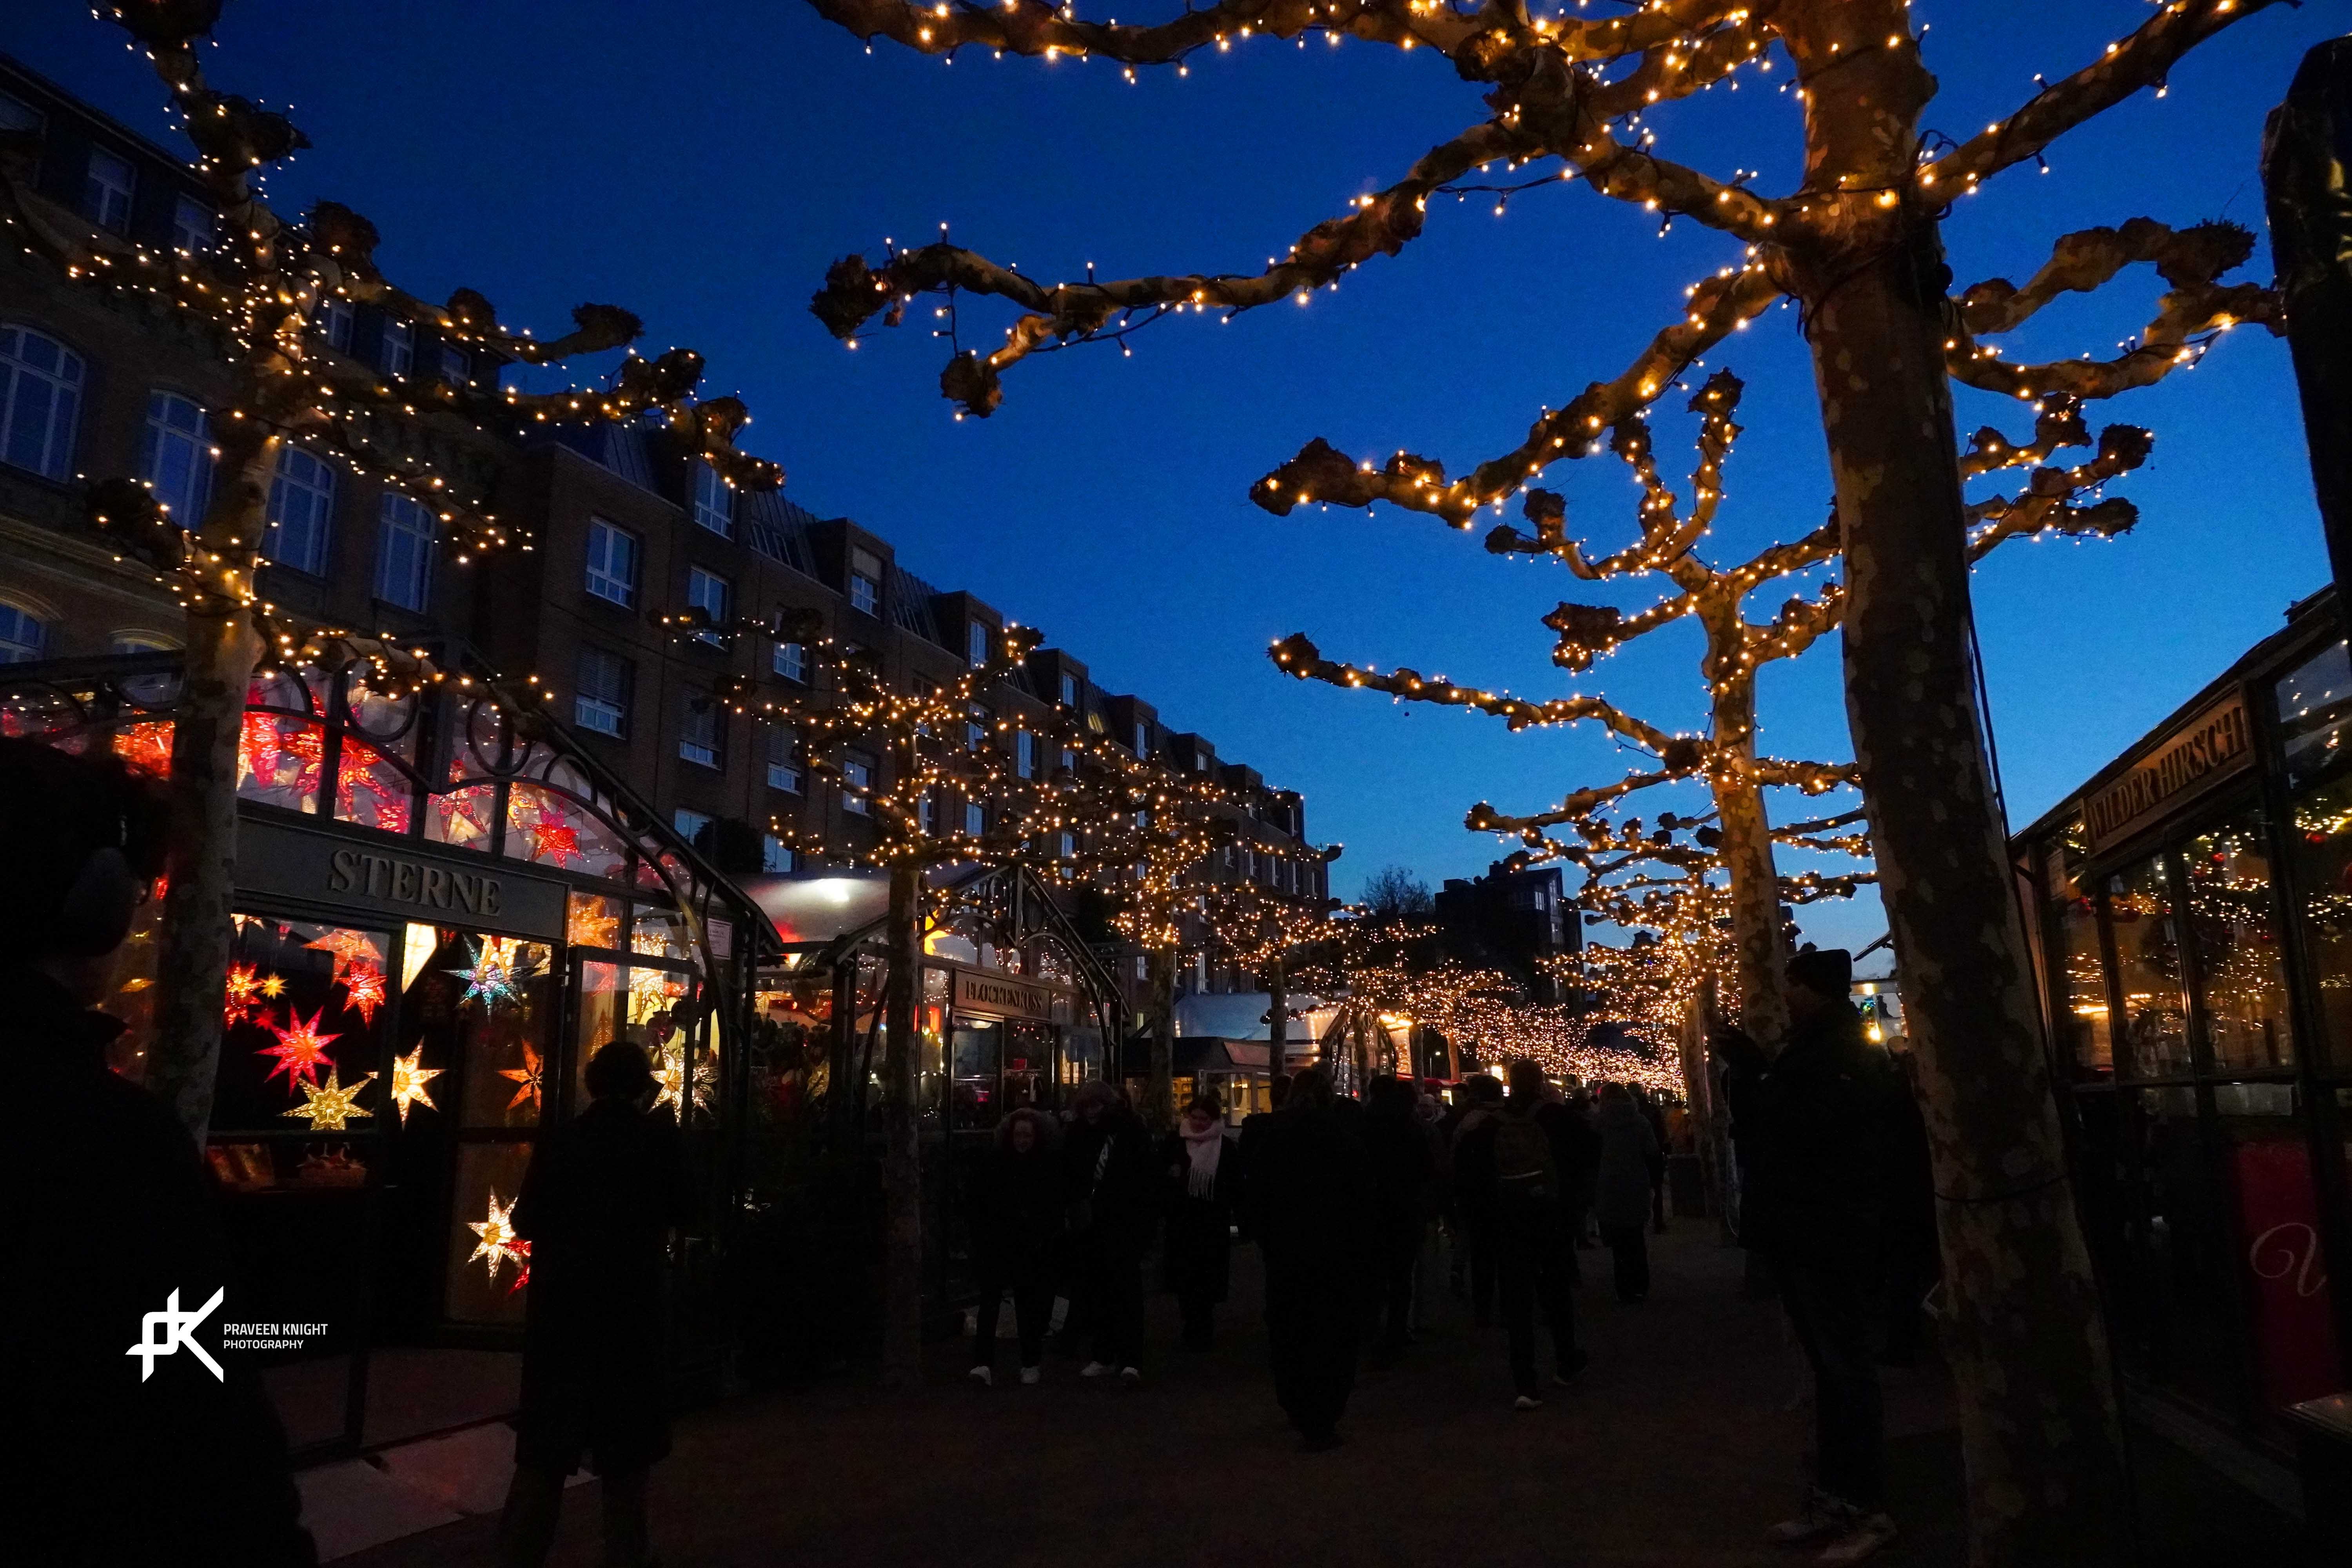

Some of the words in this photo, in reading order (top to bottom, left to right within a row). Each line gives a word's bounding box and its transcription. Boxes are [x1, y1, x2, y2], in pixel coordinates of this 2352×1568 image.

[2159, 706, 2248, 800] HIRSCH
[328, 849, 501, 916] STERNE
[965, 980, 1043, 1011] FLOCKENKUSS
